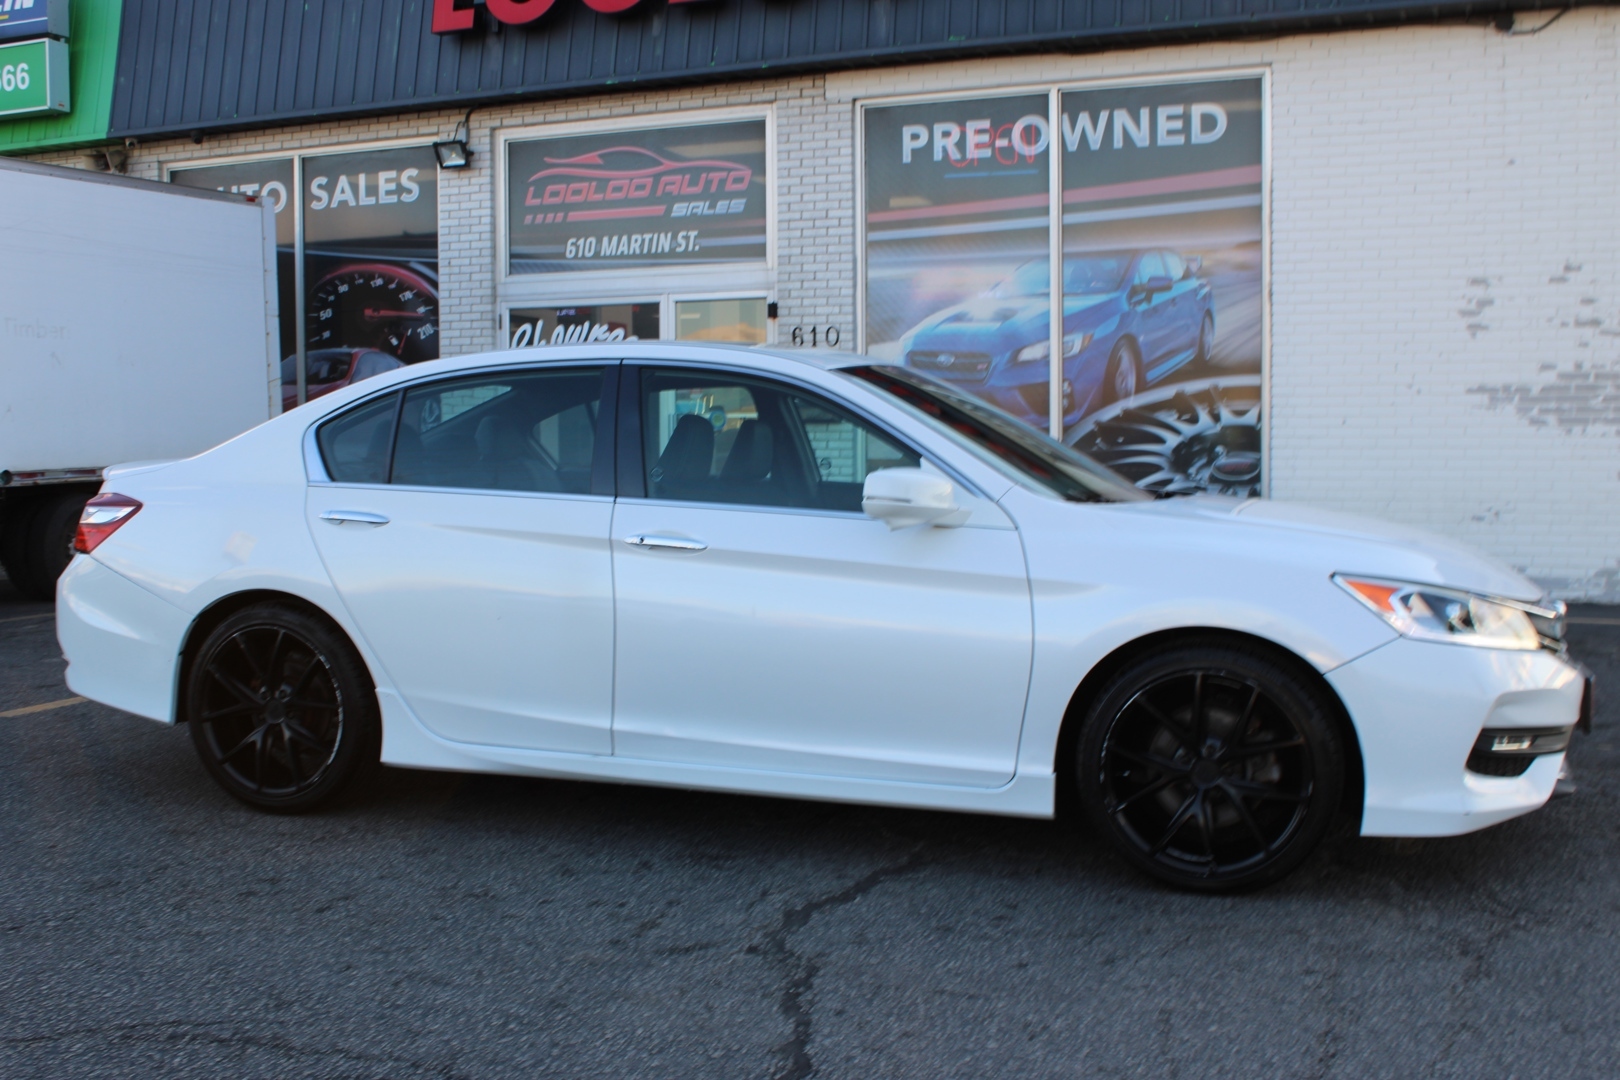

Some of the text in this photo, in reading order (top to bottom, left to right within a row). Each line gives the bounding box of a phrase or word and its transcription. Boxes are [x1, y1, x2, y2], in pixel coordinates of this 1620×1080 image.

[0, 62, 30, 92] 66
[902, 103, 1228, 163] PRE-OWNED
[310, 168, 420, 211] SALES
[524, 169, 752, 206] LOOLOO AUTO
[670, 198, 748, 218] SALES
[565, 230, 700, 259] 610 MARTIN ST.
[320, 308, 332, 320] 50
[792, 325, 840, 348] 610
